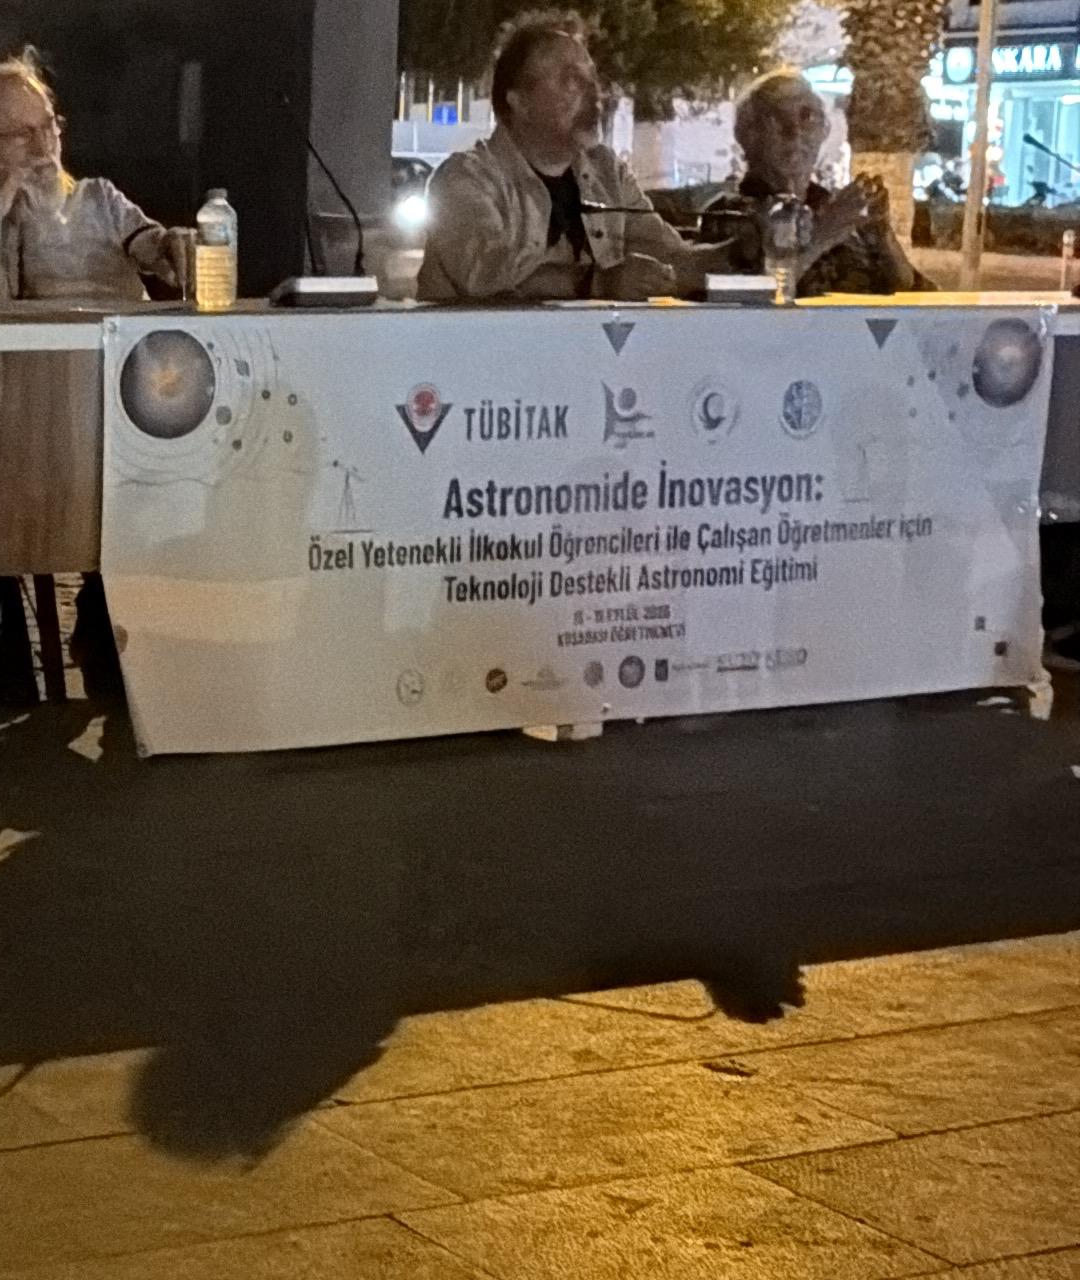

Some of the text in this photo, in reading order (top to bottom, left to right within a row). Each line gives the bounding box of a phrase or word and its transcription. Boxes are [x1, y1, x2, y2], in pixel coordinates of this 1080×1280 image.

[463, 398, 569, 442] TÜBİTAK
[443, 459, 824, 520] Astronomide İnovasyon:
[308, 512, 933, 571] Özel Yetenekli İlkokul Öğrencileri ile Çalışan Öğretmenler için
[443, 554, 818, 605] Teknoloji Destekli Astronomi Eğitimi
